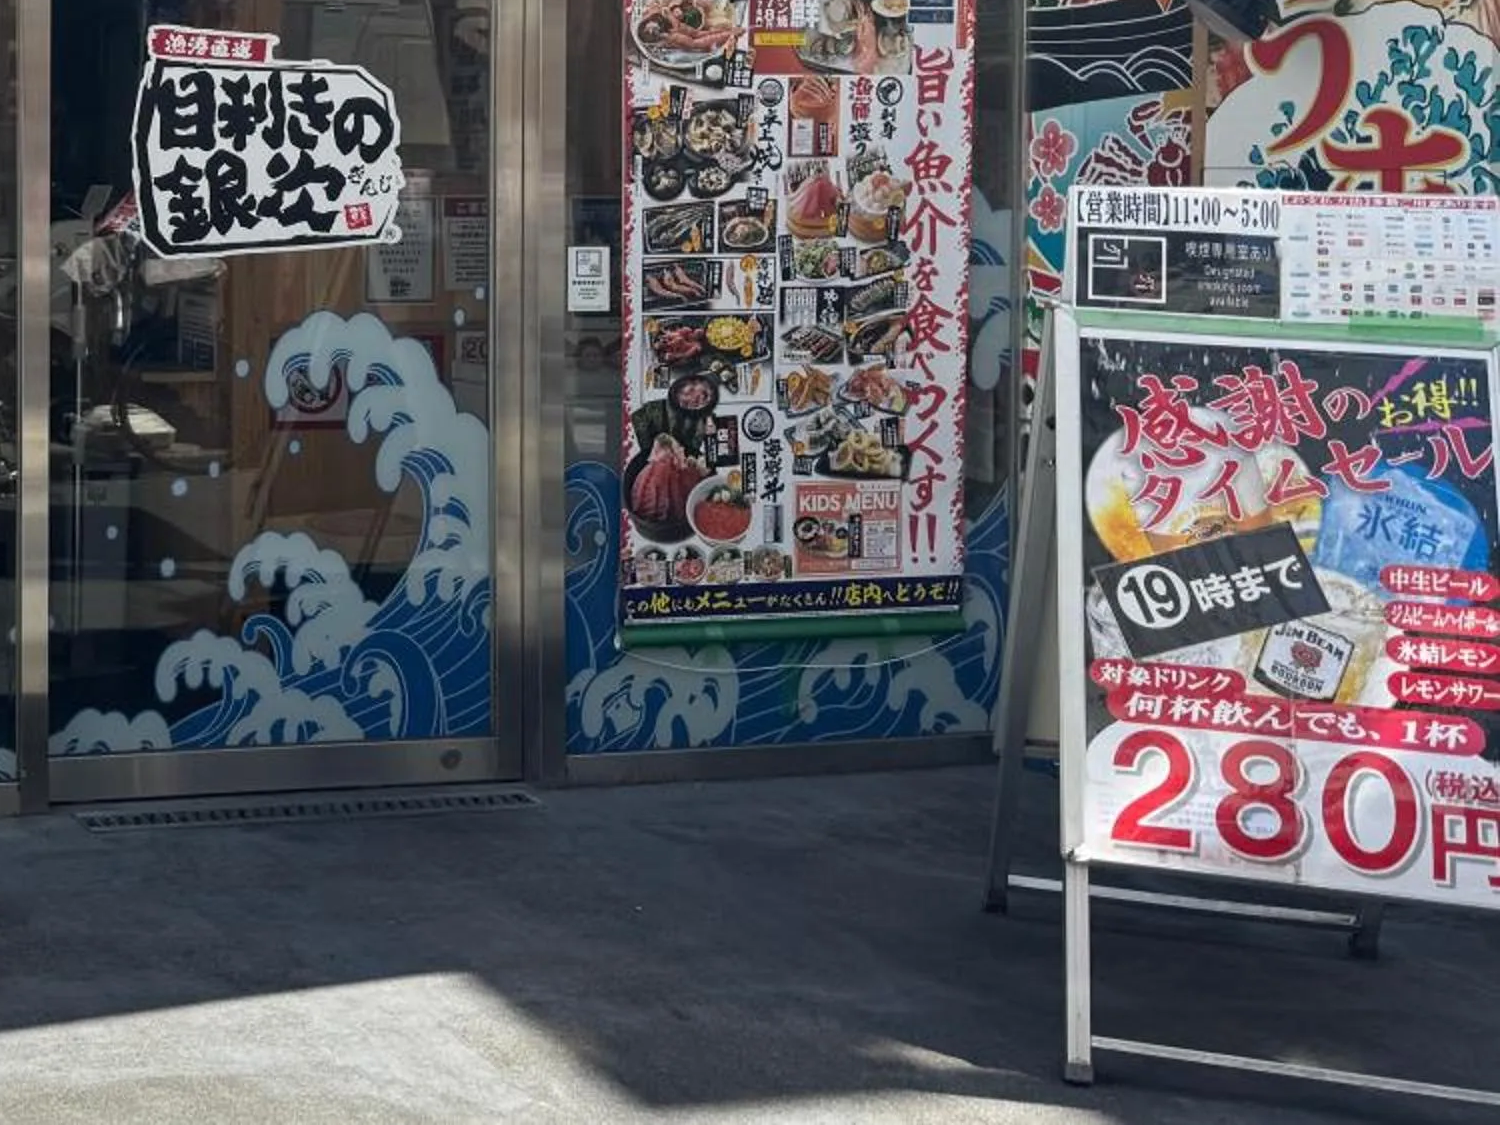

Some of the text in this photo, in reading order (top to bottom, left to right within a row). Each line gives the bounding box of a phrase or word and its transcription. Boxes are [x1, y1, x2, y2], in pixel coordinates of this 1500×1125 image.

[159, 70, 395, 164] 目利きの
[153, 148, 347, 245] 銀次
[1115, 360, 1372, 469] 感謝の
[1379, 378, 1478, 428] お得!!
[799, 490, 898, 513] KIDS MENU
[1131, 424, 1494, 531] タイムセール
[1356, 503, 1443, 562] 氷結
[1389, 568, 1490, 596] 中生ビール
[1098, 662, 1235, 695] 対象ドリンク
[1396, 639, 1498, 668] 氷結レモン
[1401, 676, 1500, 704] レモンサワー
